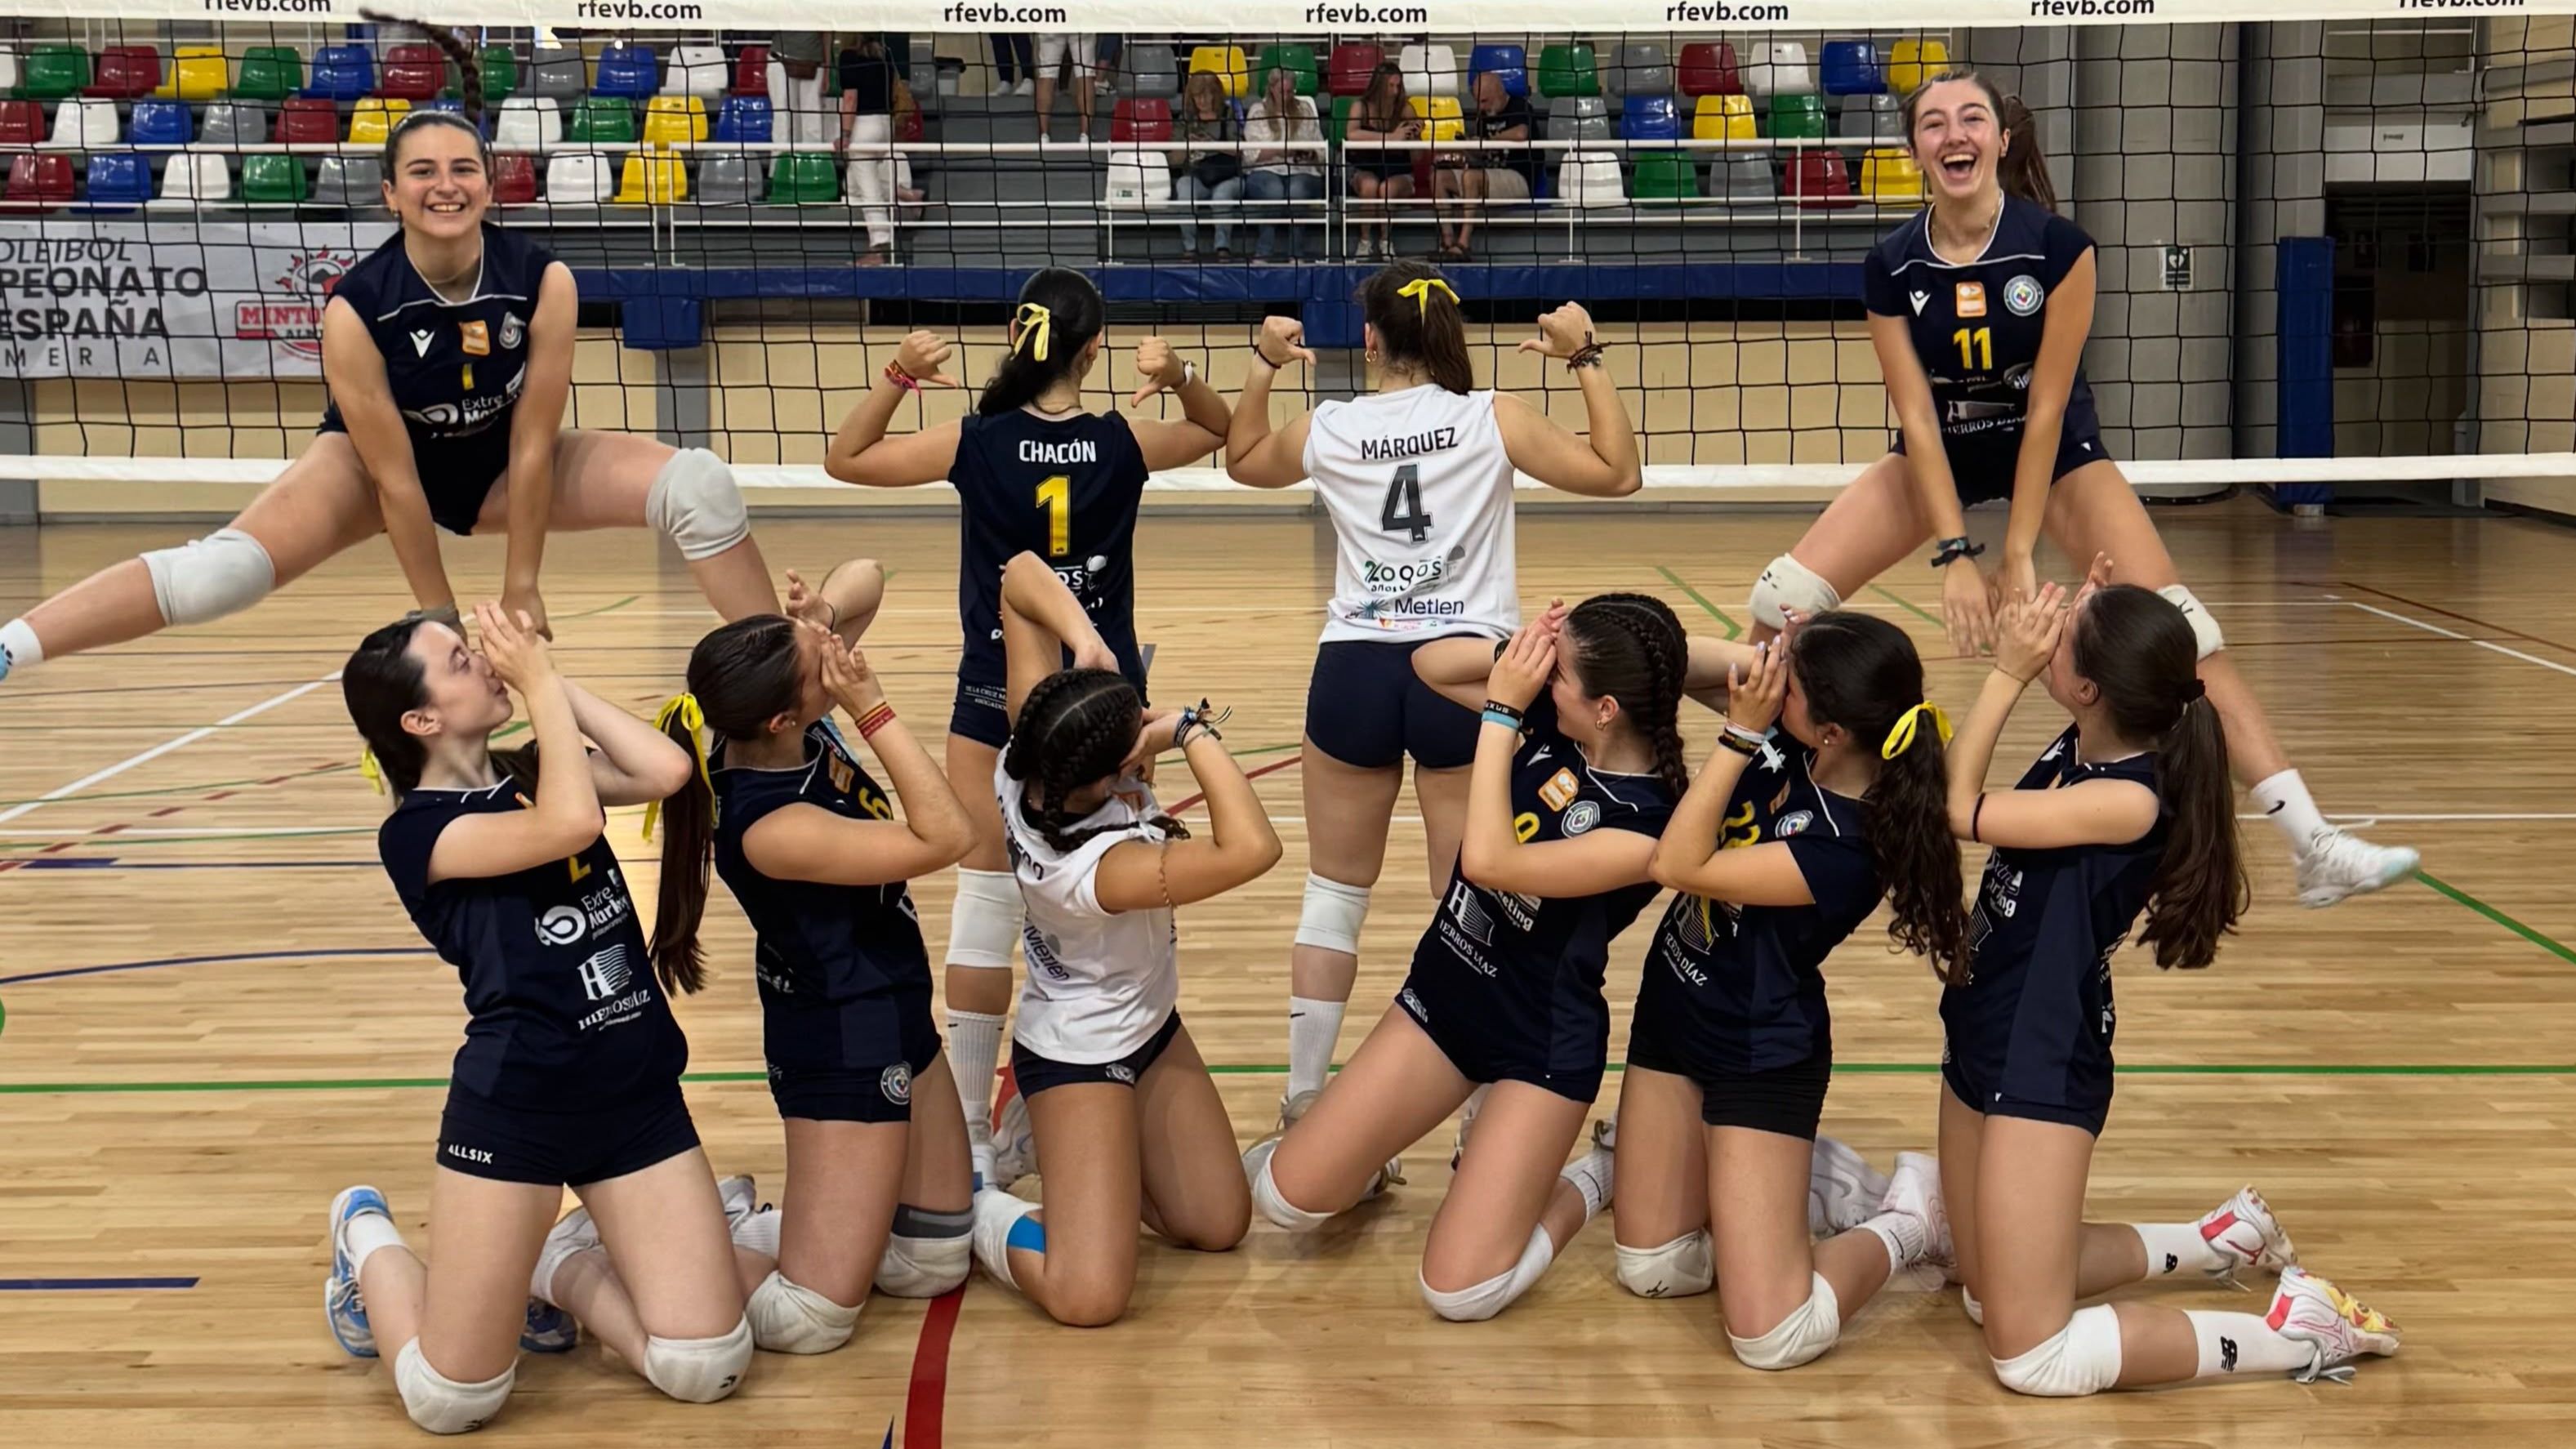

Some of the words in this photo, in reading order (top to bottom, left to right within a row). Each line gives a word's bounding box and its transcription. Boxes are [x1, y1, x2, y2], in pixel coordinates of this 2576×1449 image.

[577, 0, 702, 19] rfevb.com
[944, 2, 1066, 23] rfevb.com
[1306, 2, 1427, 23] rfevb.com
[1667, 1, 1789, 21] rfevb.com
[2031, 0, 2154, 16] rfevb.com
[1953, 327, 1993, 370] 11
[1018, 439, 1097, 464] CHACÓN
[1361, 426, 1458, 460] MÁRQUEZ
[1379, 461, 1433, 544] 4
[1035, 475, 1071, 557] 1
[1394, 597, 1464, 615] Metlen
[448, 1144, 493, 1165] ALLSIX
